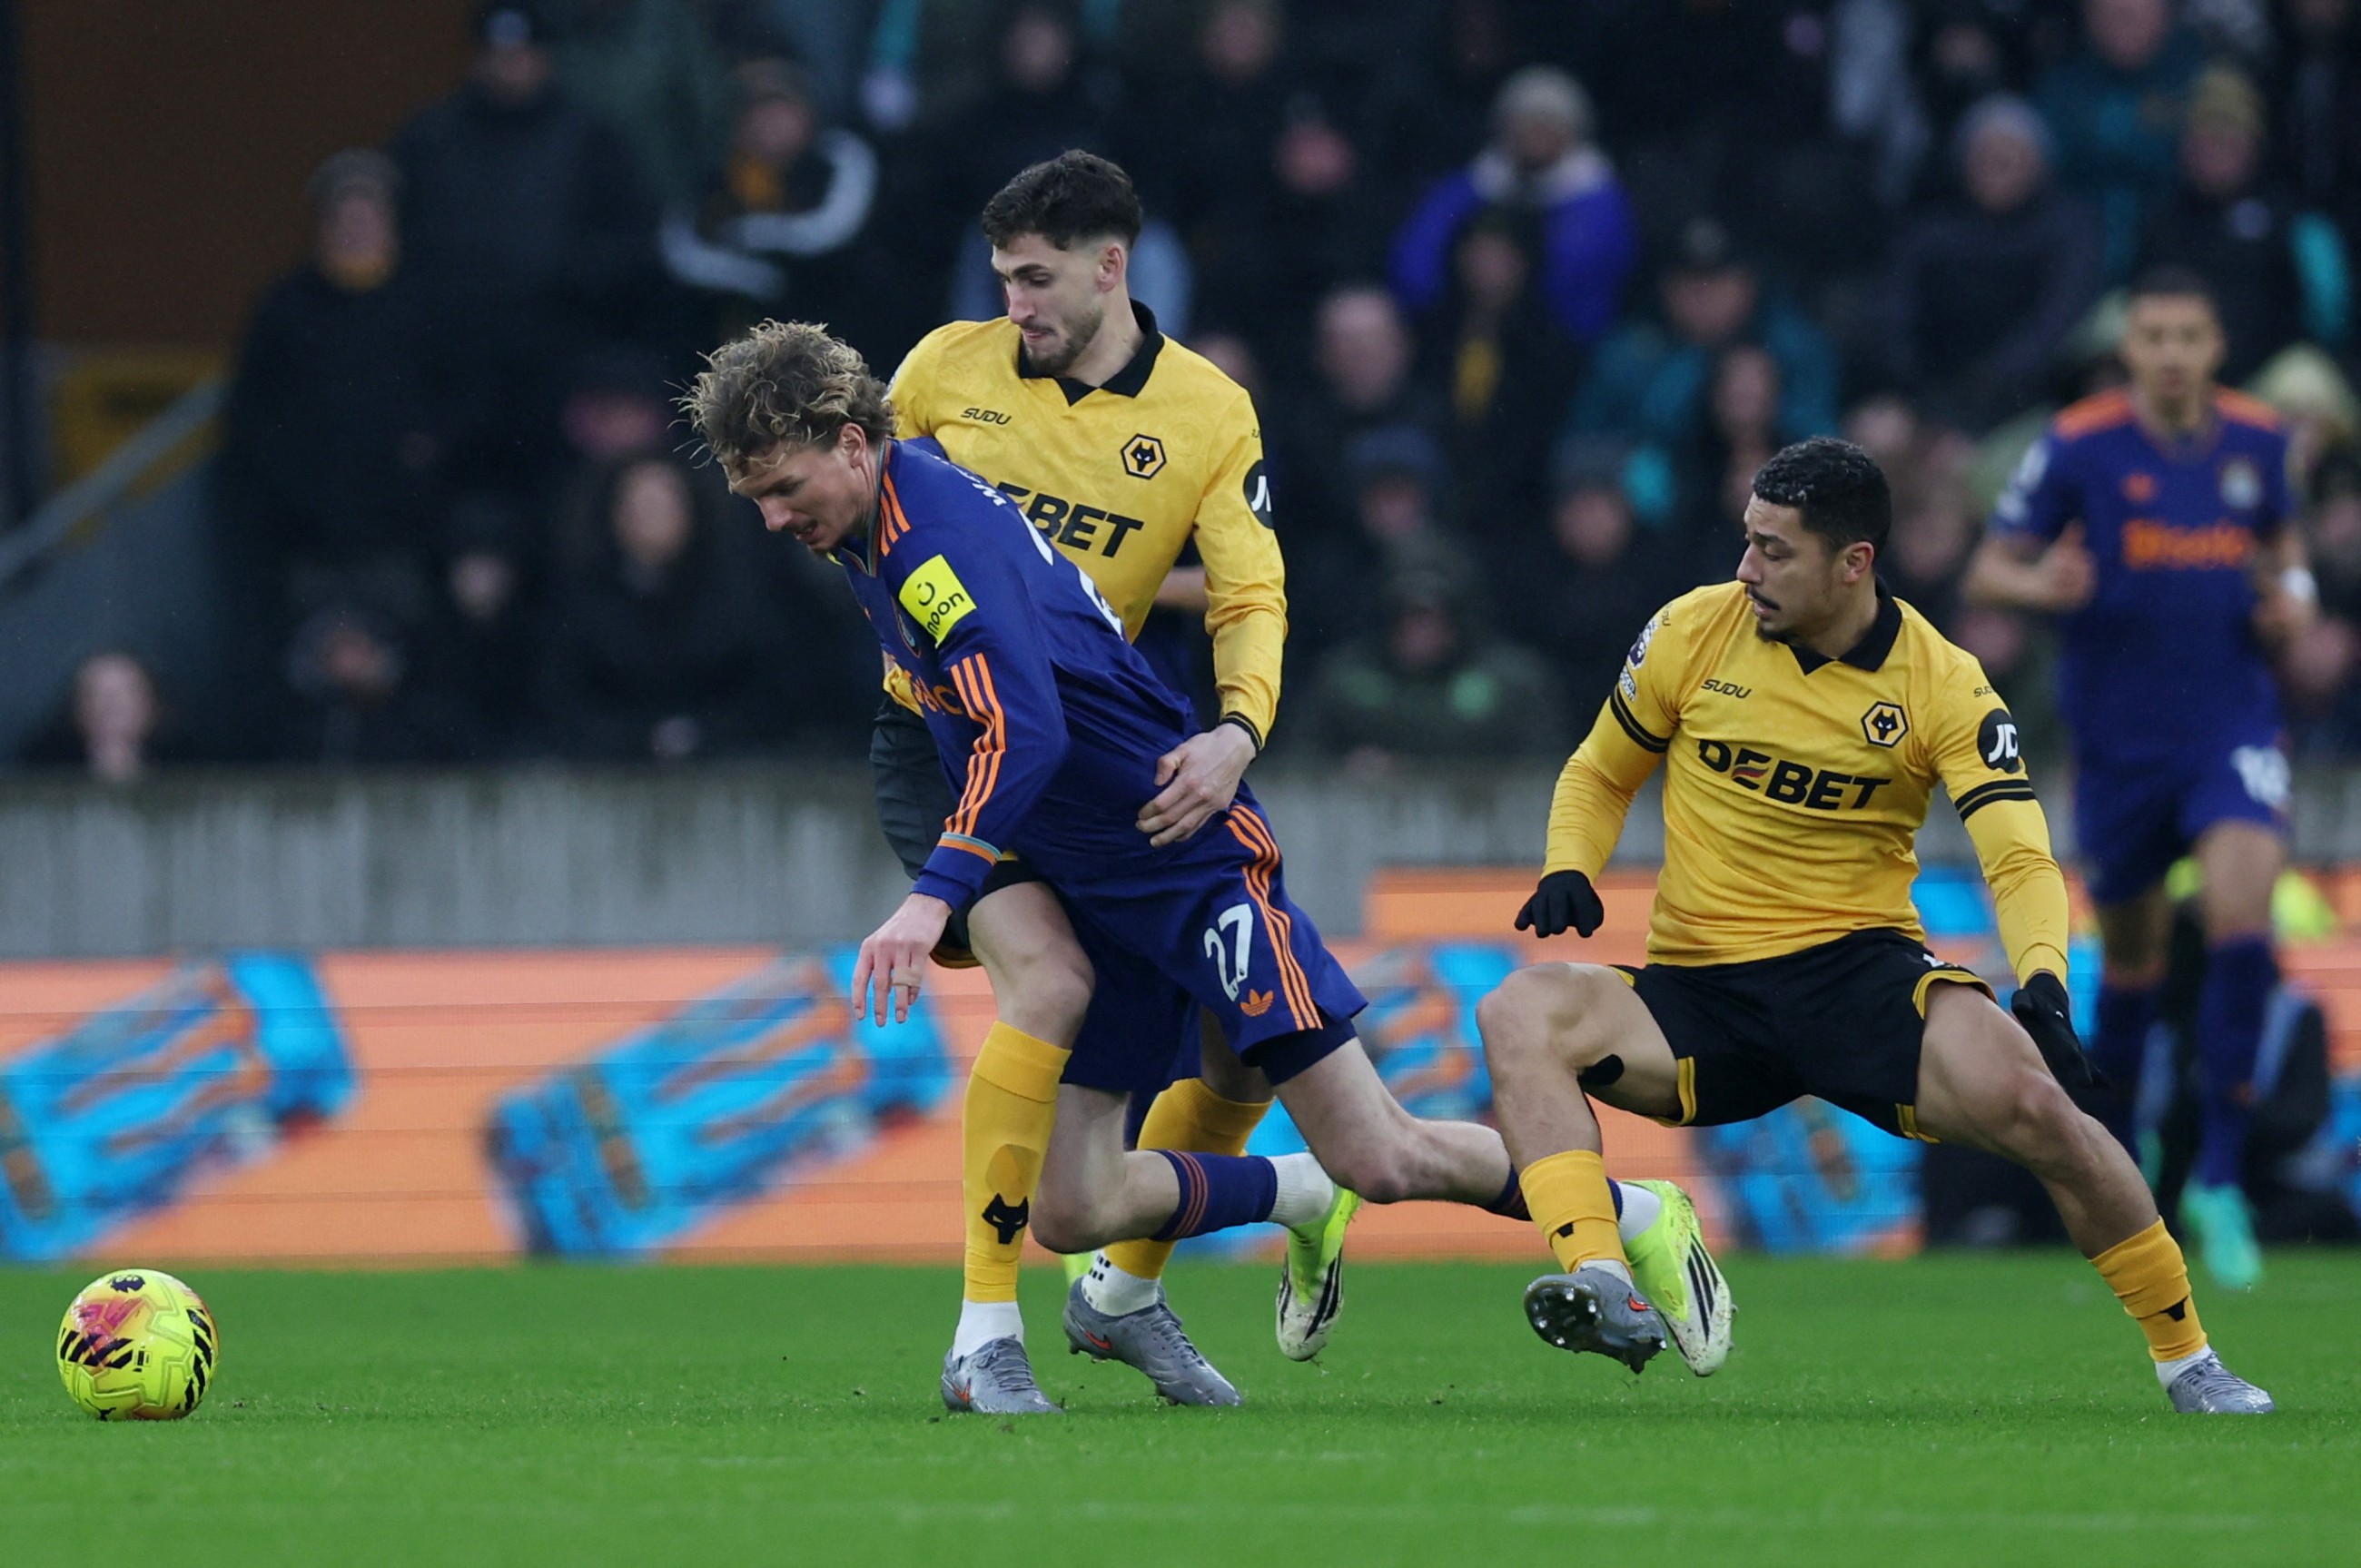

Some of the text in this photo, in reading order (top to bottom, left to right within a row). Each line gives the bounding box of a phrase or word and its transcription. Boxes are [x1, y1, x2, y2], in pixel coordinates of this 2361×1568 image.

[961, 407, 1012, 425] SUDU
[926, 592, 965, 636] noon
[1701, 678, 1752, 699] SUDU
[1988, 723, 2019, 763] JD
[1698, 738, 1892, 810] DEBET
[1203, 902, 1254, 1002] 27
